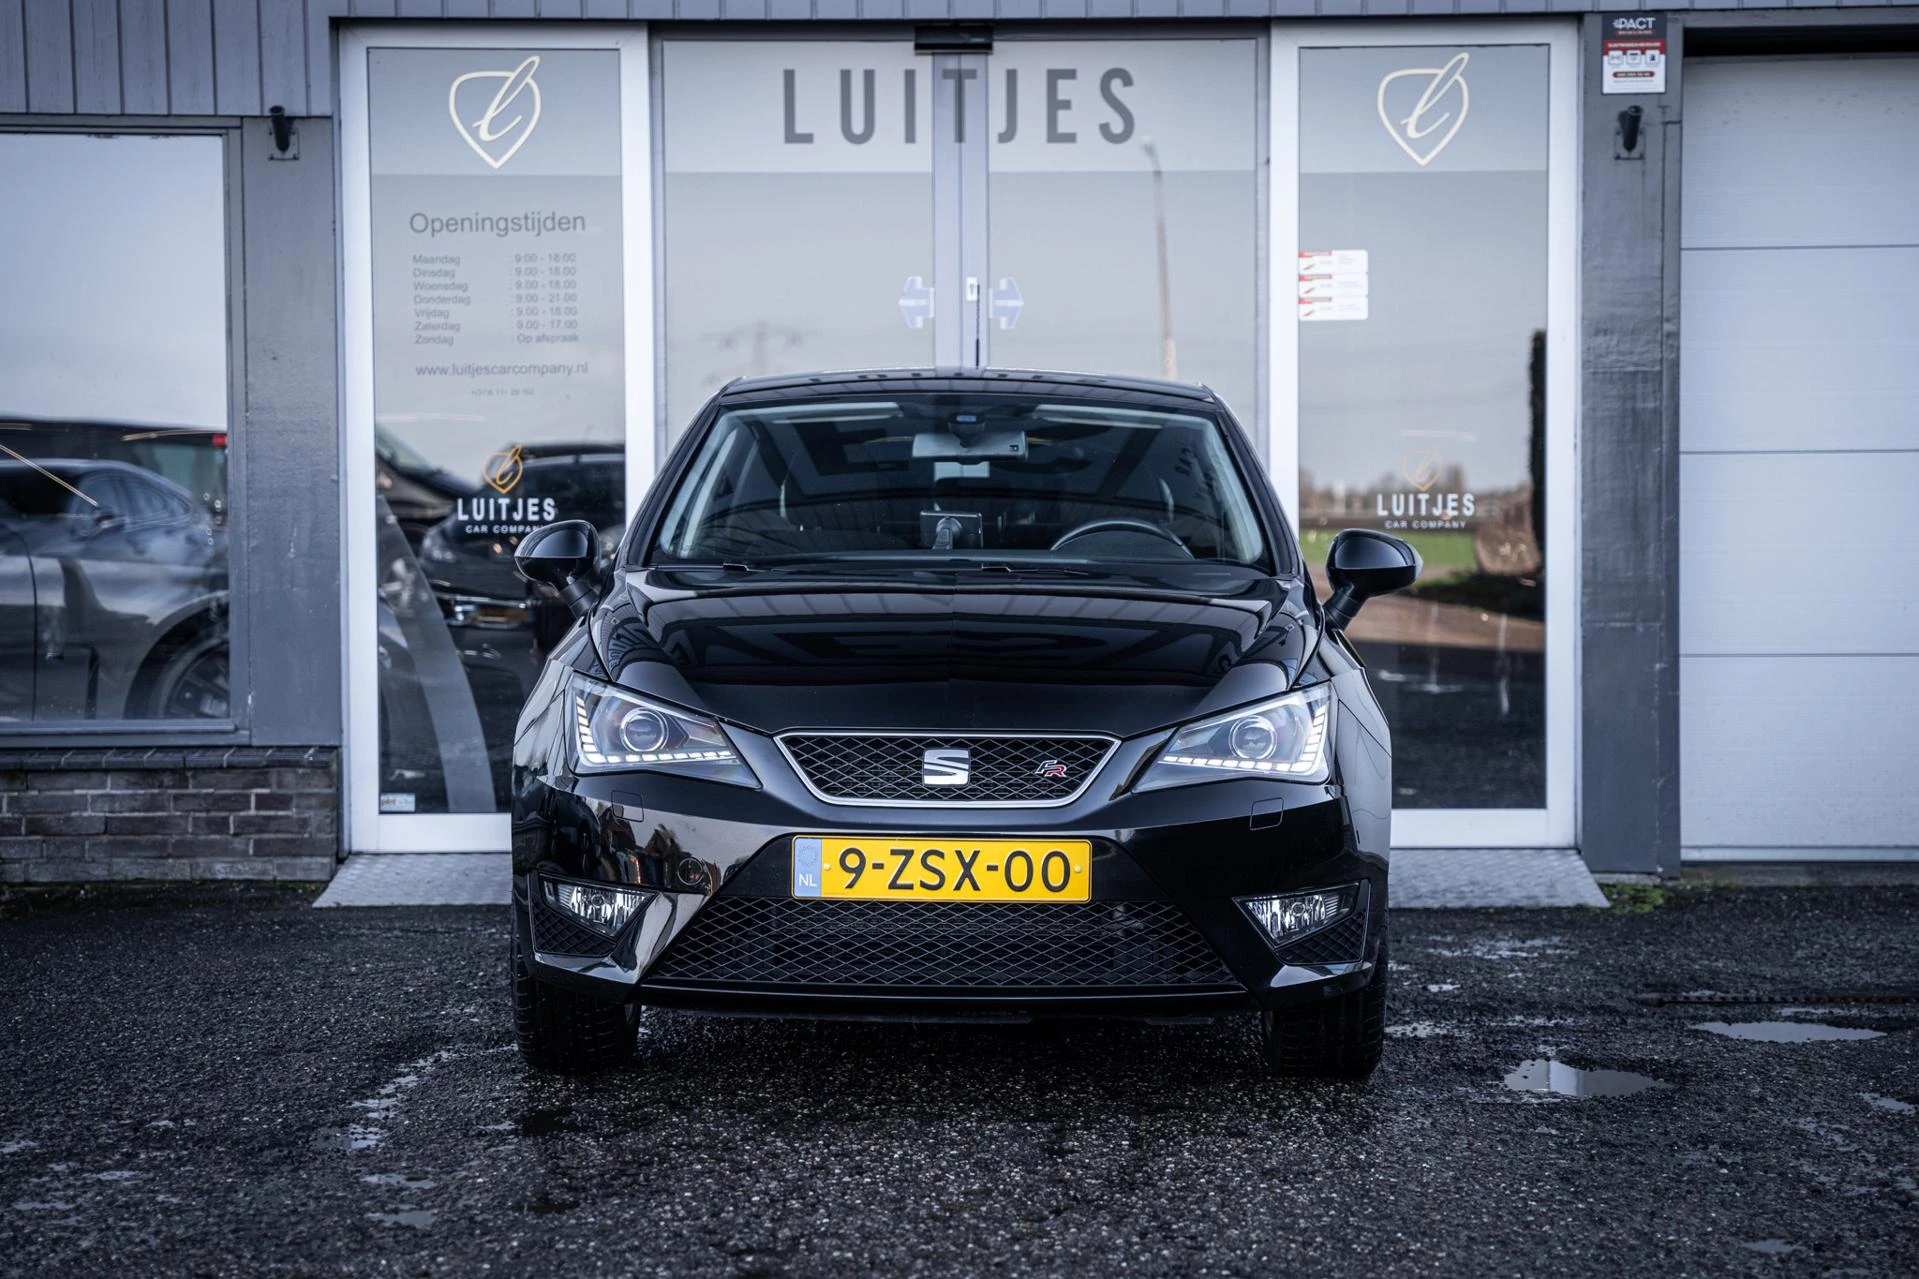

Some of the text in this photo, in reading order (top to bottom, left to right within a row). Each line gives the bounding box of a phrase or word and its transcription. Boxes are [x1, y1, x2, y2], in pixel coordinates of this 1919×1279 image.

[783, 67, 1135, 145] LUITJES
[409, 211, 587, 238] Openingstijden
[414, 334, 454, 346] Zondag
[415, 361, 589, 378] www.luitjescarcompany.nl
[457, 497, 556, 521] LUITJES
[1376, 493, 1475, 517] LUITJES
[465, 524, 544, 534] CAR COMPAN
[1384, 519, 1467, 529] CAR COMPANY
[1035, 759, 1067, 778] FR
[799, 873, 817, 887] NL
